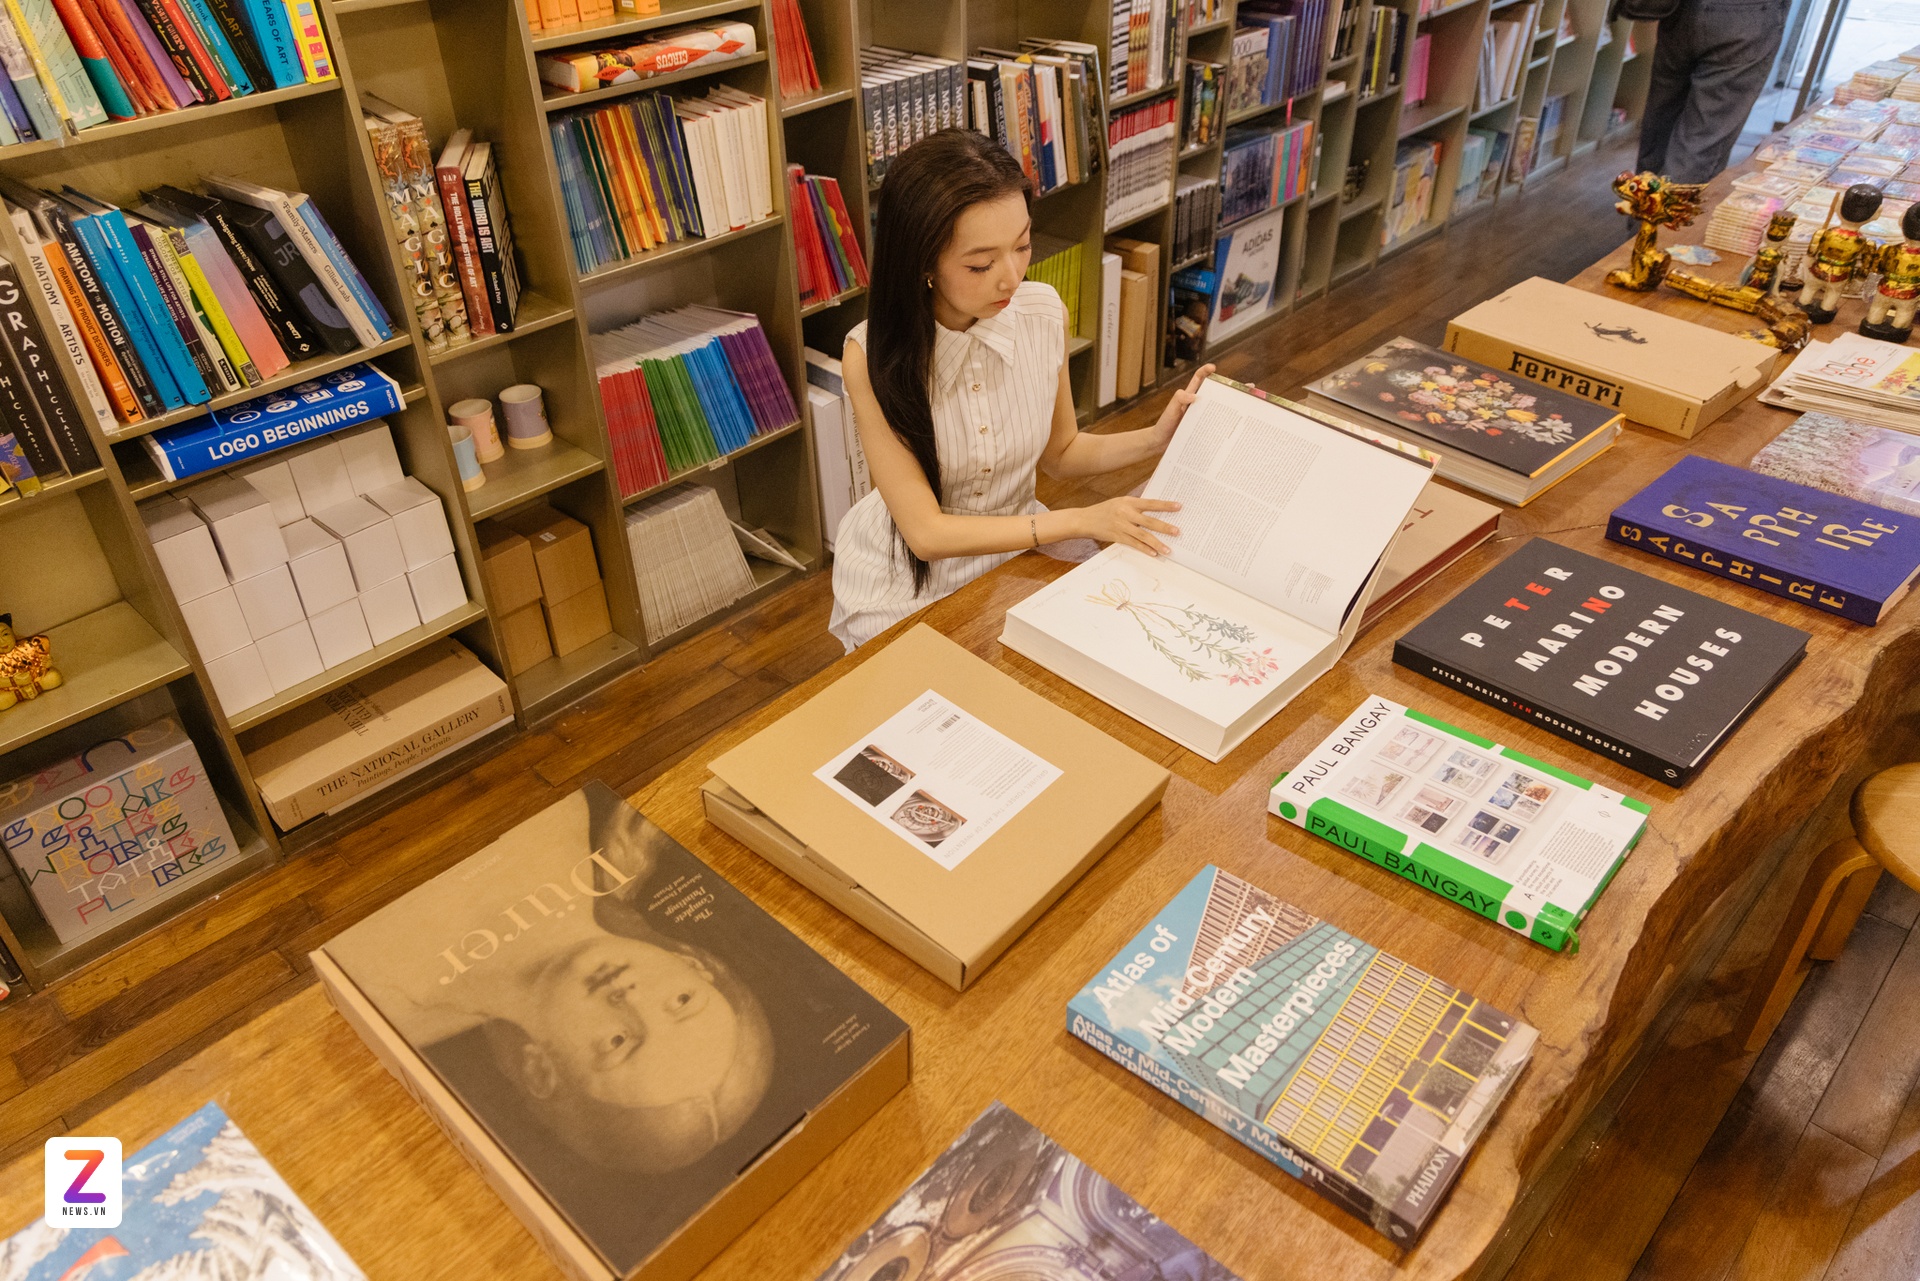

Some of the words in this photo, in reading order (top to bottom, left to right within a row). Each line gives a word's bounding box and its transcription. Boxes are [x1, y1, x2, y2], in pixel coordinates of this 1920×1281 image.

[190, 11, 198, 23] Third
[271, 28, 282, 45] OF
[275, 45, 289, 66] ART
[656, 50, 689, 70] CIRCUS
[873, 109, 885, 161] MONET
[915, 97, 924, 141] MONE
[928, 93, 937, 135] MONE
[449, 191, 459, 205] THE
[468, 180, 483, 198] THE
[471, 198, 488, 226] WORD
[216, 214, 238, 246] Designing
[235, 241, 256, 272] Here/Now
[283, 201, 300, 228] Family
[298, 226, 318, 254] Matters
[391, 187, 433, 297] MAGIC
[415, 181, 456, 288] MAGIC
[451, 204, 469, 243] HOLLYWOOD
[477, 224, 490, 236] IS
[480, 235, 494, 255] ART
[1241, 228, 1274, 254] ADIDAS
[154, 236, 170, 262] COLORS
[168, 262, 177, 276] FOR
[174, 276, 191, 302] ARTISTS
[273, 241, 300, 267] JR
[330, 250, 340, 262] Paper
[346, 275, 358, 290] Science
[460, 241, 473, 267] HISTORY
[467, 267, 475, 276] OF
[65, 242, 99, 293] ANATOMY
[96, 303, 126, 346] MOTION
[151, 272, 161, 285] STILL
[166, 302, 179, 321] ARTISTS
[158, 269, 168, 282] STILL
[173, 300, 187, 319] ARTISTS
[323, 264, 340, 287] Gillian
[337, 285, 350, 303] Laub
[468, 275, 478, 288] ART
[490, 271, 500, 290] Michael
[30, 255, 60, 306] ANATOMY
[60, 323, 86, 366] ARTISTS
[58, 266, 77, 295] DRAWING
[72, 295, 82, 309] FOR
[79, 308, 97, 339] PRODUCT
[92, 336, 112, 367] DESIGNERS
[1508, 351, 1625, 407] Ferrari
[208, 434, 260, 461] LOGO
[261, 400, 370, 445] BEGINNINGS
[1620, 525, 1846, 609] SAPPHIRE
[1460, 566, 1574, 649] PETER
[1514, 585, 1625, 672] MARINO
[1572, 604, 1685, 697] MODERN
[1634, 627, 1742, 721] HOUSES
[347, 717, 370, 737] THE
[1431, 666, 1463, 684] PETER
[1466, 680, 1509, 703] MARINO
[1512, 701, 1532, 714] TEN
[1535, 710, 1582, 736] MODERN
[1586, 733, 1632, 758] HOUSES
[317, 775, 348, 797] THE
[350, 739, 420, 781] NATIONAL
[422, 707, 480, 744] GALLERY
[420, 736, 452, 756] Portraits
[1292, 758, 1339, 794] PAUL
[1332, 702, 1392, 756] BANGAY
[1310, 816, 1375, 859] PAUL
[1384, 851, 1495, 913] BANGAY
[436, 847, 637, 985] Dürer
[664, 885, 707, 917] Paintings
[675, 892, 715, 924] Complete
[693, 906, 714, 924] The
[1092, 947, 1156, 1011] Atlas
[1149, 923, 1179, 954] of
[1139, 904, 1277, 1040] Mid-Century
[1162, 964, 1259, 1057] Modern
[1215, 938, 1356, 1090] Masterpieces
[1072, 1025, 1181, 1101] Masterpieces
[1072, 1014, 1113, 1044] Atlas
[1116, 1041, 1135, 1057] of
[1138, 1054, 1247, 1132] Mid-Century
[1250, 1122, 1325, 1182] Modern
[1405, 1148, 1451, 1208] PHAIDON
